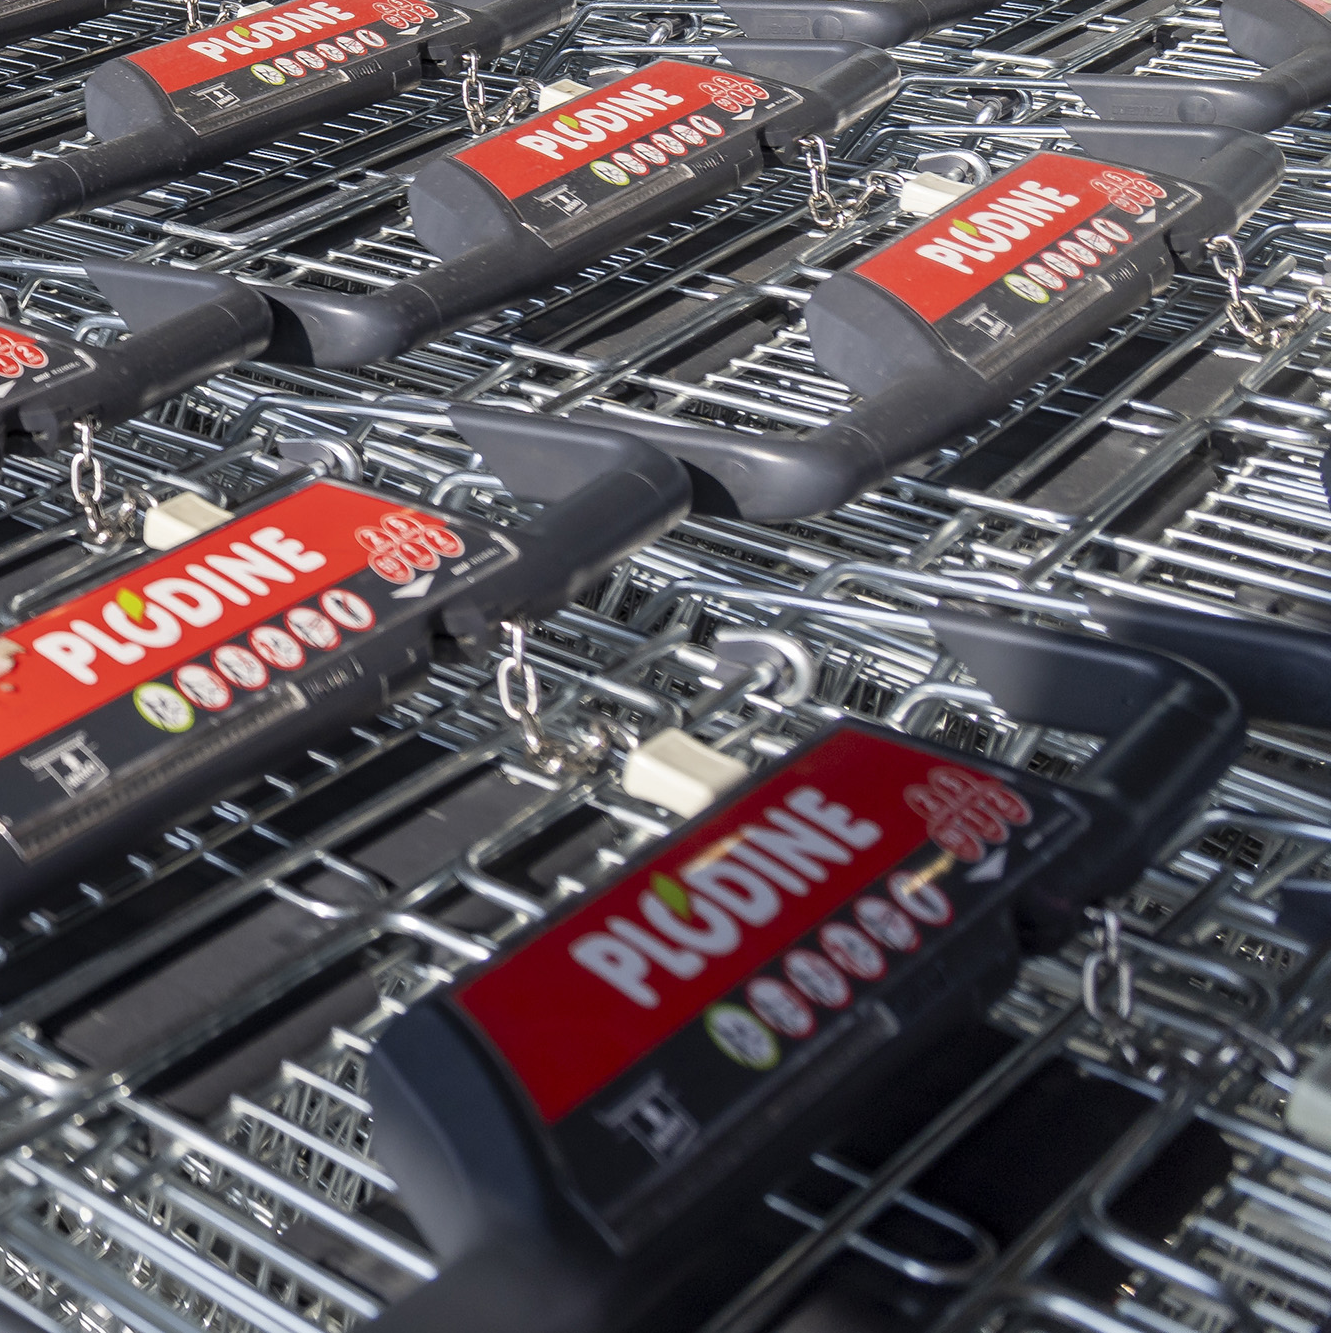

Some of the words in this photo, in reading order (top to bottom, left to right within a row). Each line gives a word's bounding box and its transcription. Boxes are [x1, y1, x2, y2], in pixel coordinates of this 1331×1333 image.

[187, 1, 355, 62] PLODINE
[517, 83, 684, 161] PLODINE
[916, 180, 1080, 275] PLODINE
[33, 526, 326, 684] PLODINE
[569, 786, 883, 1008] PLODINE
